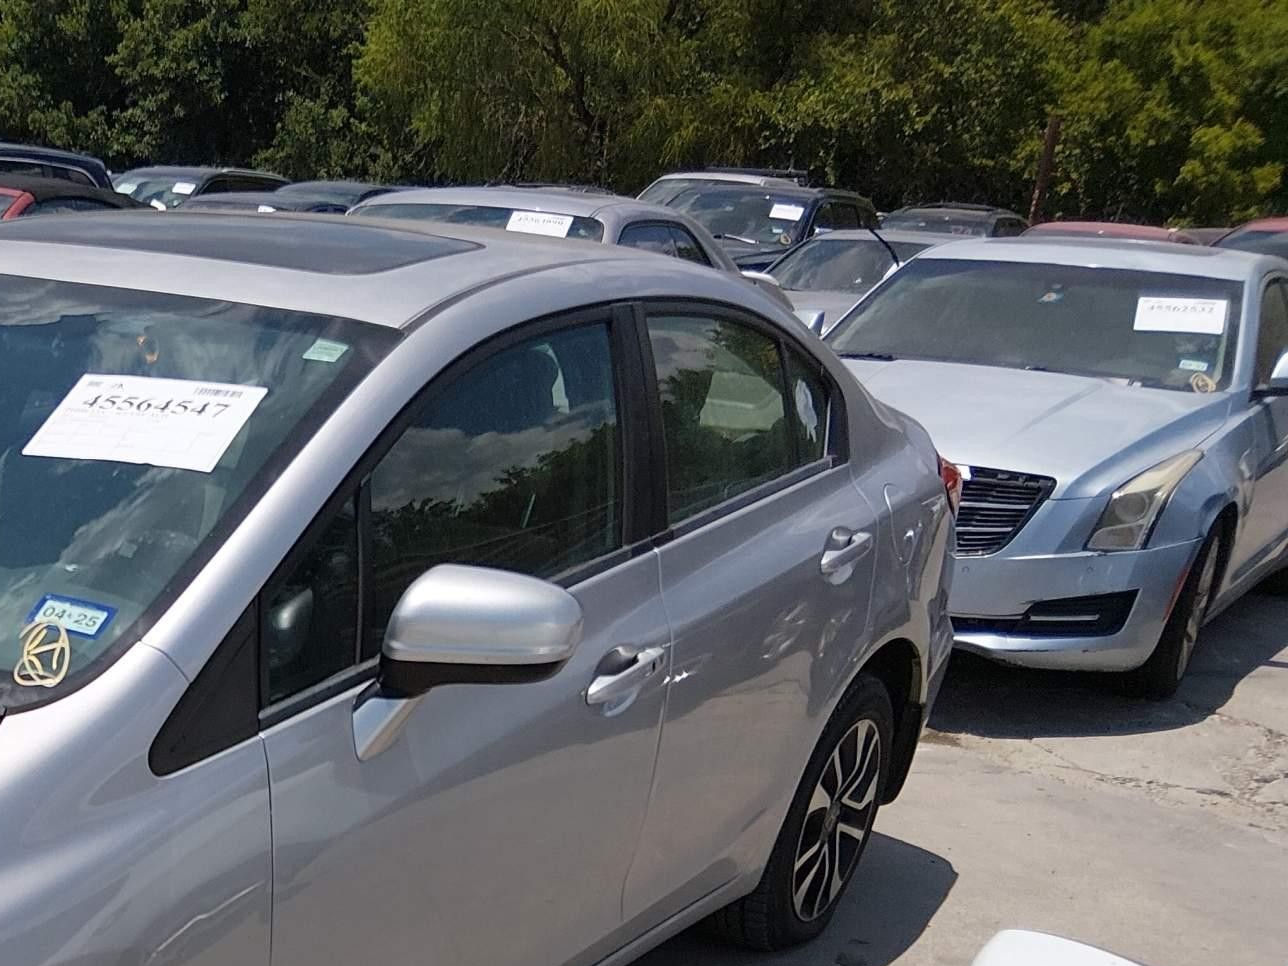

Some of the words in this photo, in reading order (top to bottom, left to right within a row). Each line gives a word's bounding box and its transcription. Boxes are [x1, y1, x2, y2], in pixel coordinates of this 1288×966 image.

[81, 393, 232, 418] 45564547
[42, 605, 66, 619] 04
[73, 613, 101, 628] 25
